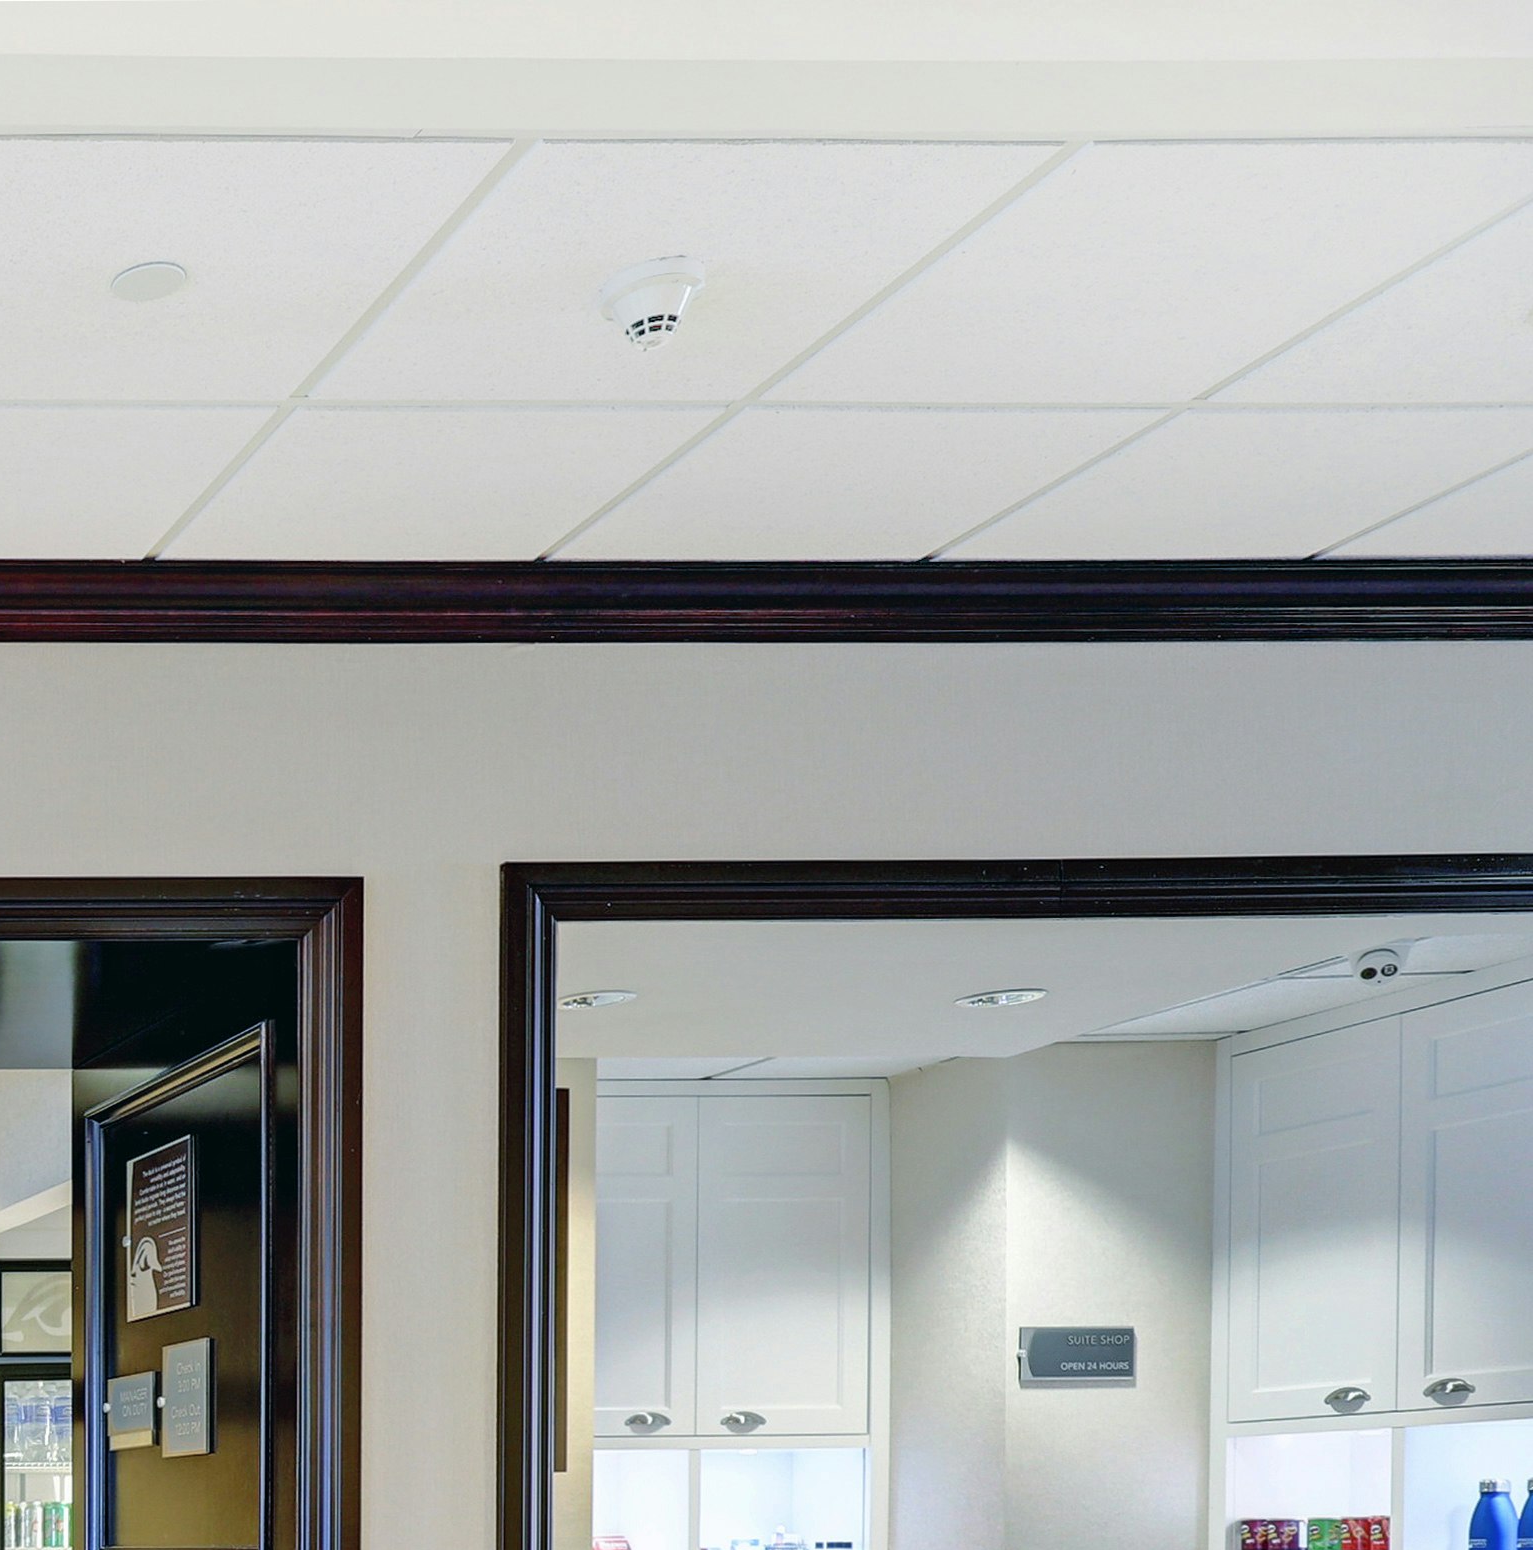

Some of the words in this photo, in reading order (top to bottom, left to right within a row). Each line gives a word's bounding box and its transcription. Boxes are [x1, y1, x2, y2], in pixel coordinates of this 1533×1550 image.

[1067, 1335, 1097, 1345] SUITE
[1100, 1334, 1130, 1345] SHOP
[1060, 1362, 1085, 1371] OPEN
[1087, 1362, 1097, 1370] 24
[1099, 1361, 1129, 1370] HOURS
